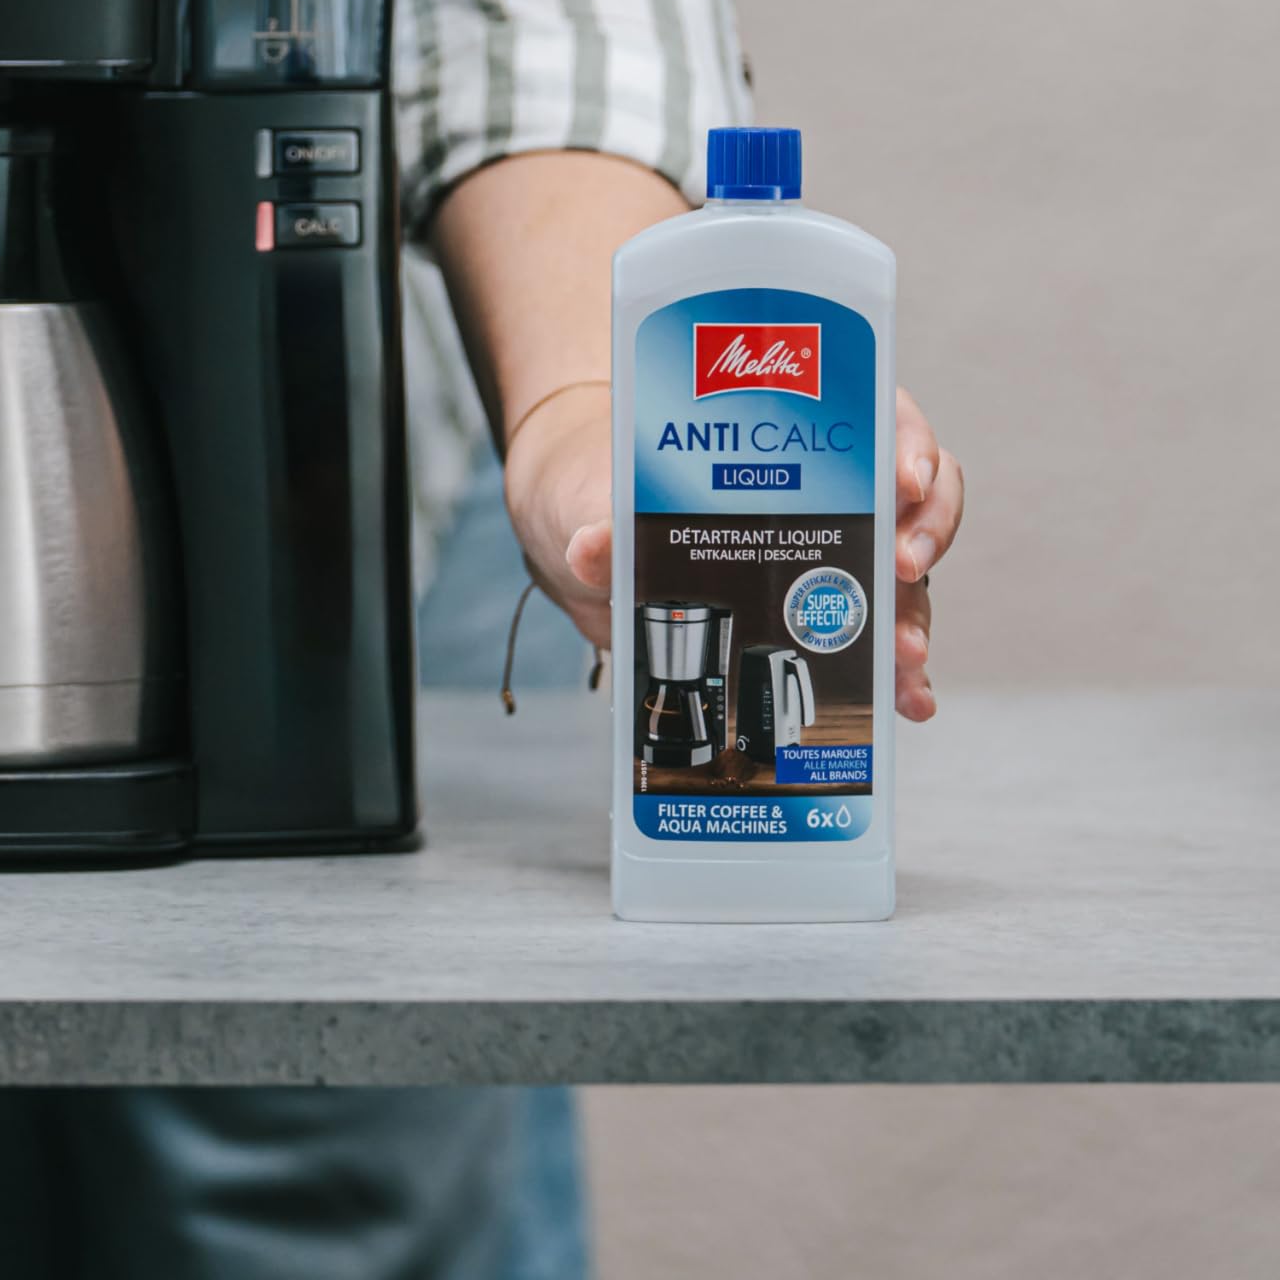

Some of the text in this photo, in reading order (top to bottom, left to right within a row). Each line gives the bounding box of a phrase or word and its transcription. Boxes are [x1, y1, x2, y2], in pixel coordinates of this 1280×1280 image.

[707, 334, 803, 378] Melitta
[657, 422, 854, 452] ANTI CALC
[723, 469, 790, 486] LIQUID
[670, 527, 842, 546] DÉTARTRANT LIQUIDE
[690, 549, 822, 561] ENTKALKER DESCALER
[807, 594, 845, 610] SUPER
[797, 610, 855, 626] EFFECTIVE
[783, 748, 868, 760] TOUTES MARQUES
[804, 760, 868, 770] ALLE MARKEN
[810, 770, 868, 781] ALL BRANDS
[658, 803, 783, 819] FILTER COFFEE &
[806, 808, 834, 828] 6x
[658, 819, 787, 834] AQUA MACHINES
